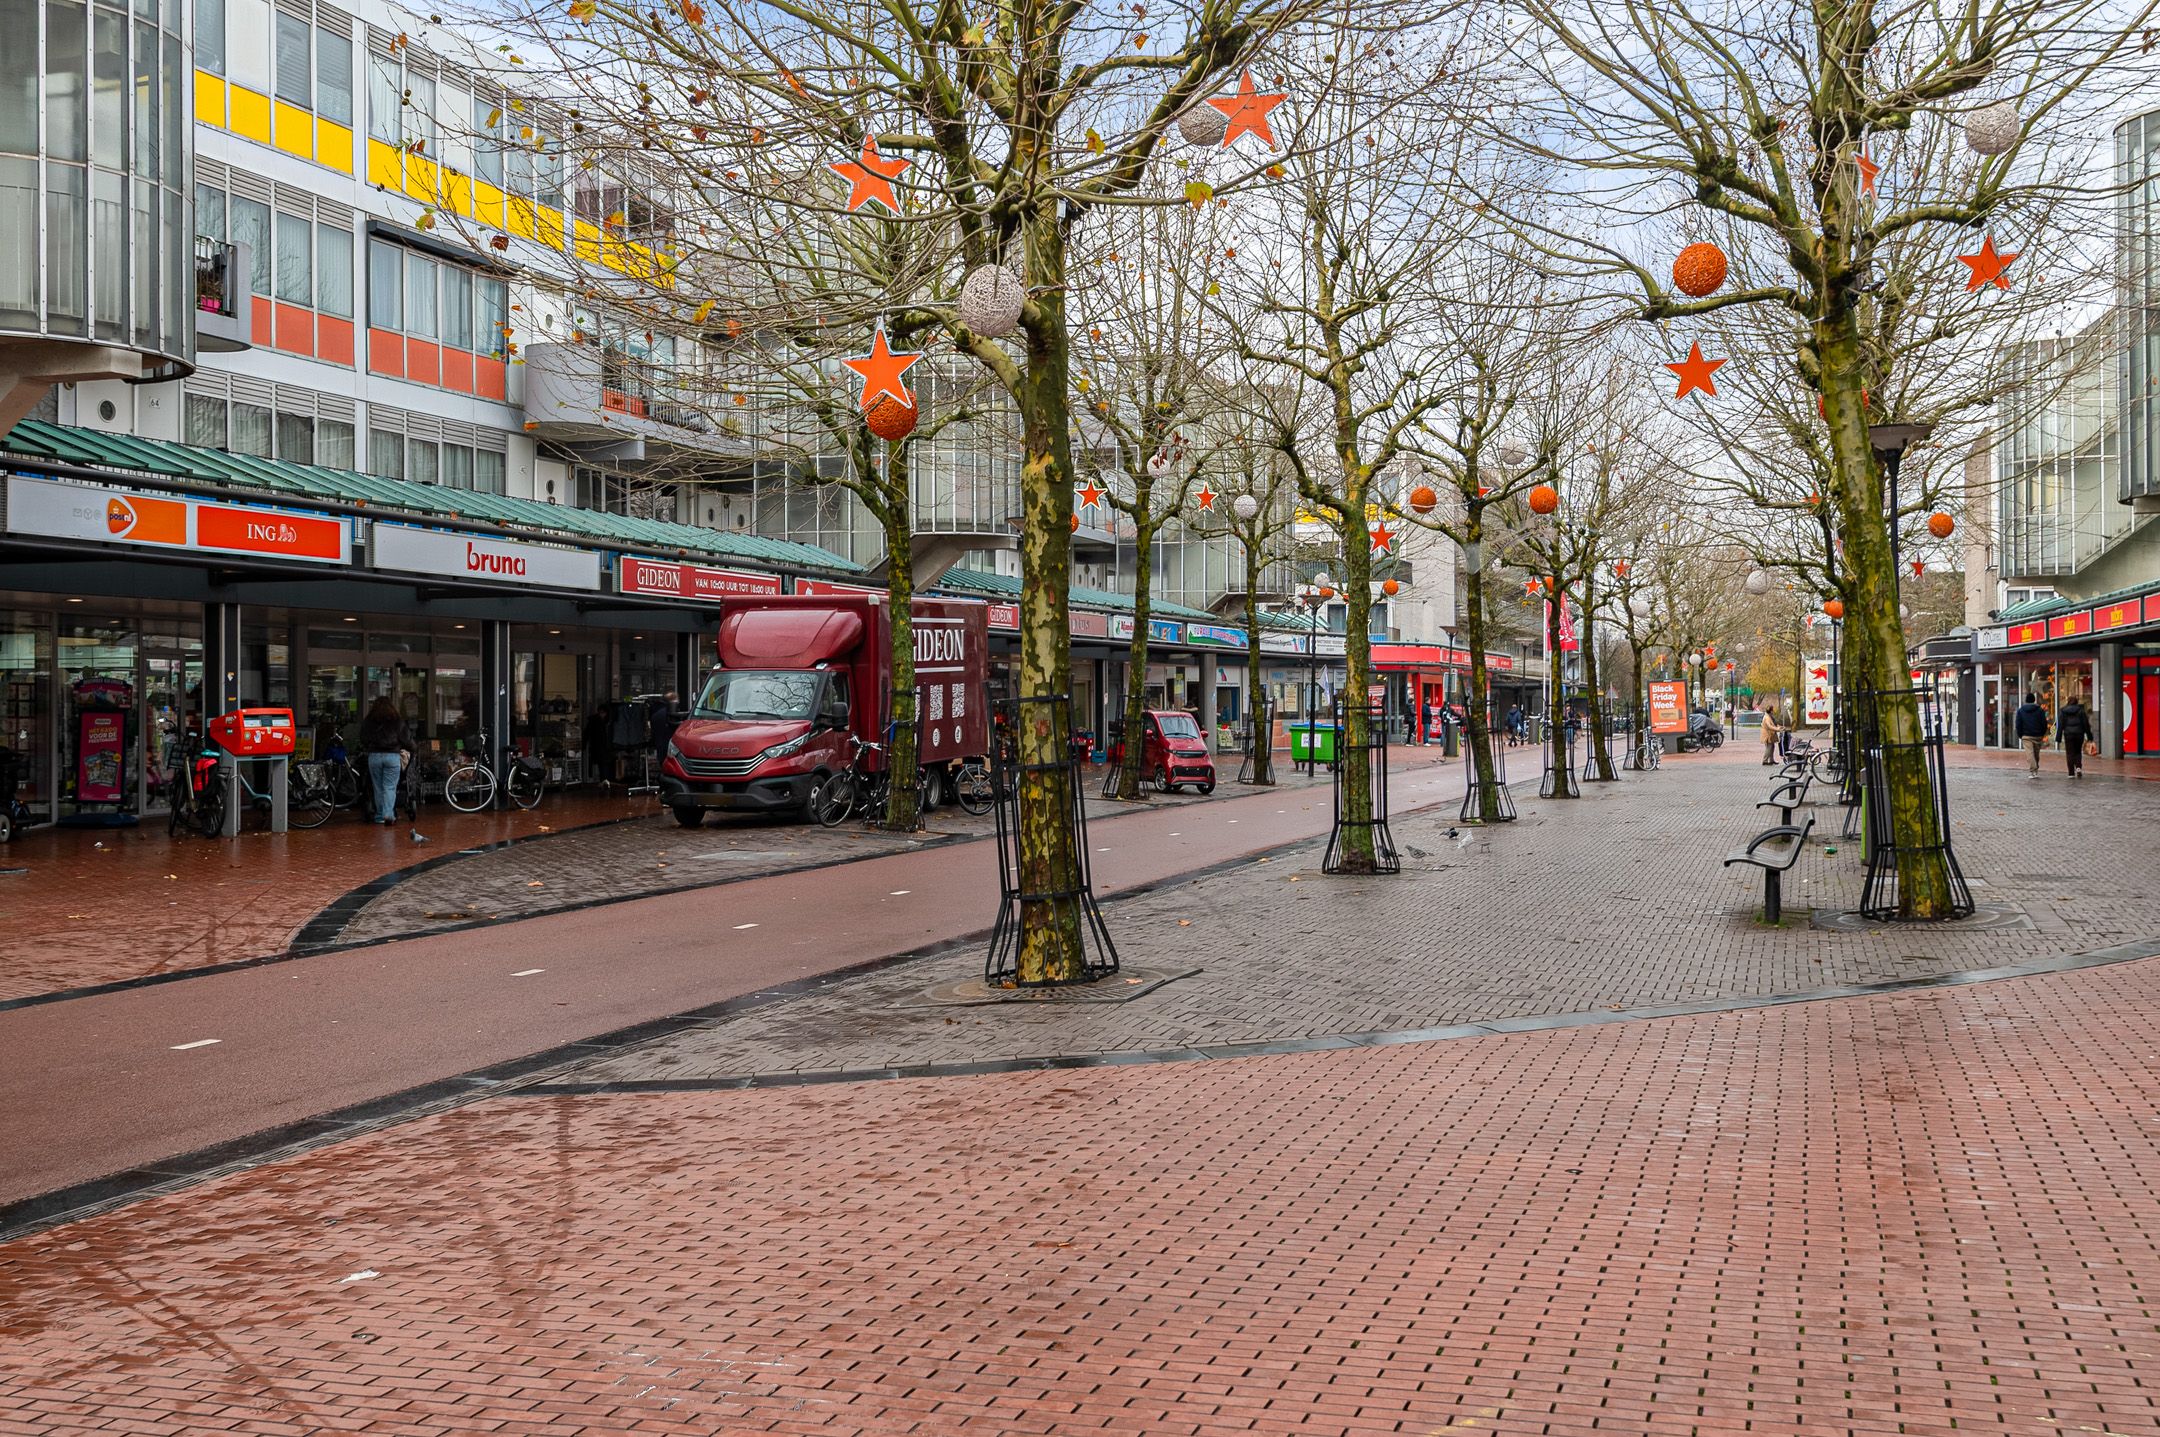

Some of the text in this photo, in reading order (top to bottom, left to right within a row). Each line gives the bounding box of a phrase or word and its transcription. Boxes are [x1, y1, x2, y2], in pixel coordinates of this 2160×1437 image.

[247, 523, 277, 541] ING
[466, 541, 526, 576] bruna
[637, 567, 680, 589] GIDEON
[695, 578, 709, 588] VAN
[726, 582, 738, 591] UUR
[739, 583, 749, 592] TOT
[765, 586, 776, 595] UUR
[989, 608, 1013, 623] GIDEON
[1652, 693, 1677, 702] Friday
[1653, 701, 1675, 709] Week
